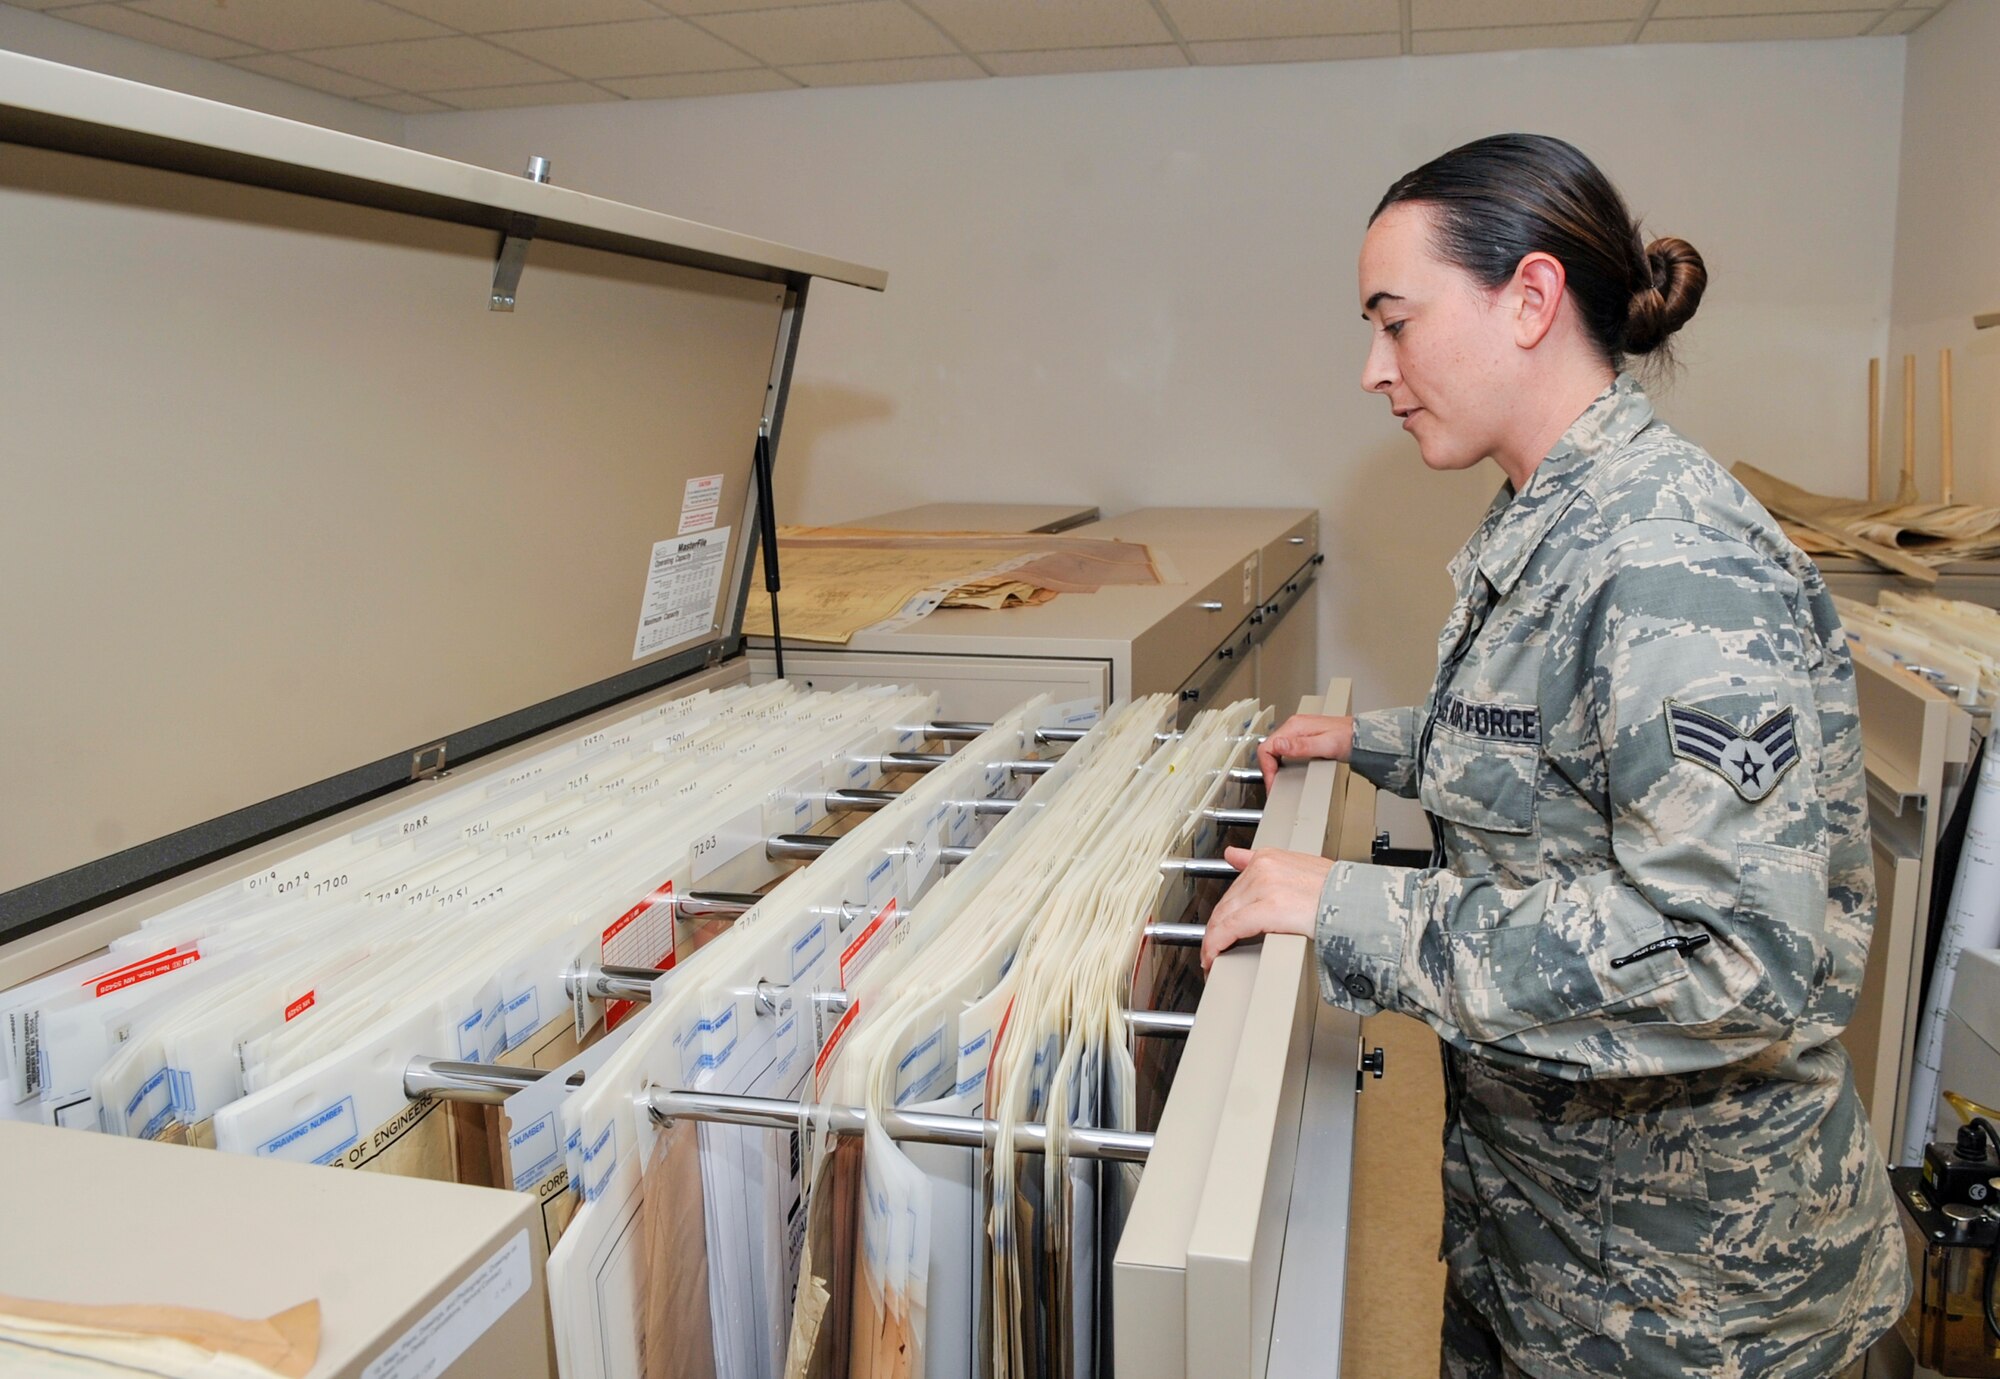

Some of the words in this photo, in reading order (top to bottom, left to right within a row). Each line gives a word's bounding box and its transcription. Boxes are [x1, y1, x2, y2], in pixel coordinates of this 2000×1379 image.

[678, 538, 708, 553] MasterFile
[655, 557, 674, 568] Operating
[675, 553, 691, 563] Capacity
[644, 616, 662, 626] Maximum
[1466, 704, 1537, 738] FORCE
[693, 835, 717, 859] 7203
[313, 874, 349, 897] 7700
[268, 1126, 309, 1153] DRAWING
[310, 1105, 344, 1130] NUMBER
[349, 1141, 368, 1163] OF
[374, 1093, 434, 1148] ENGINEERS
[513, 1121, 545, 1147] NUMBER
